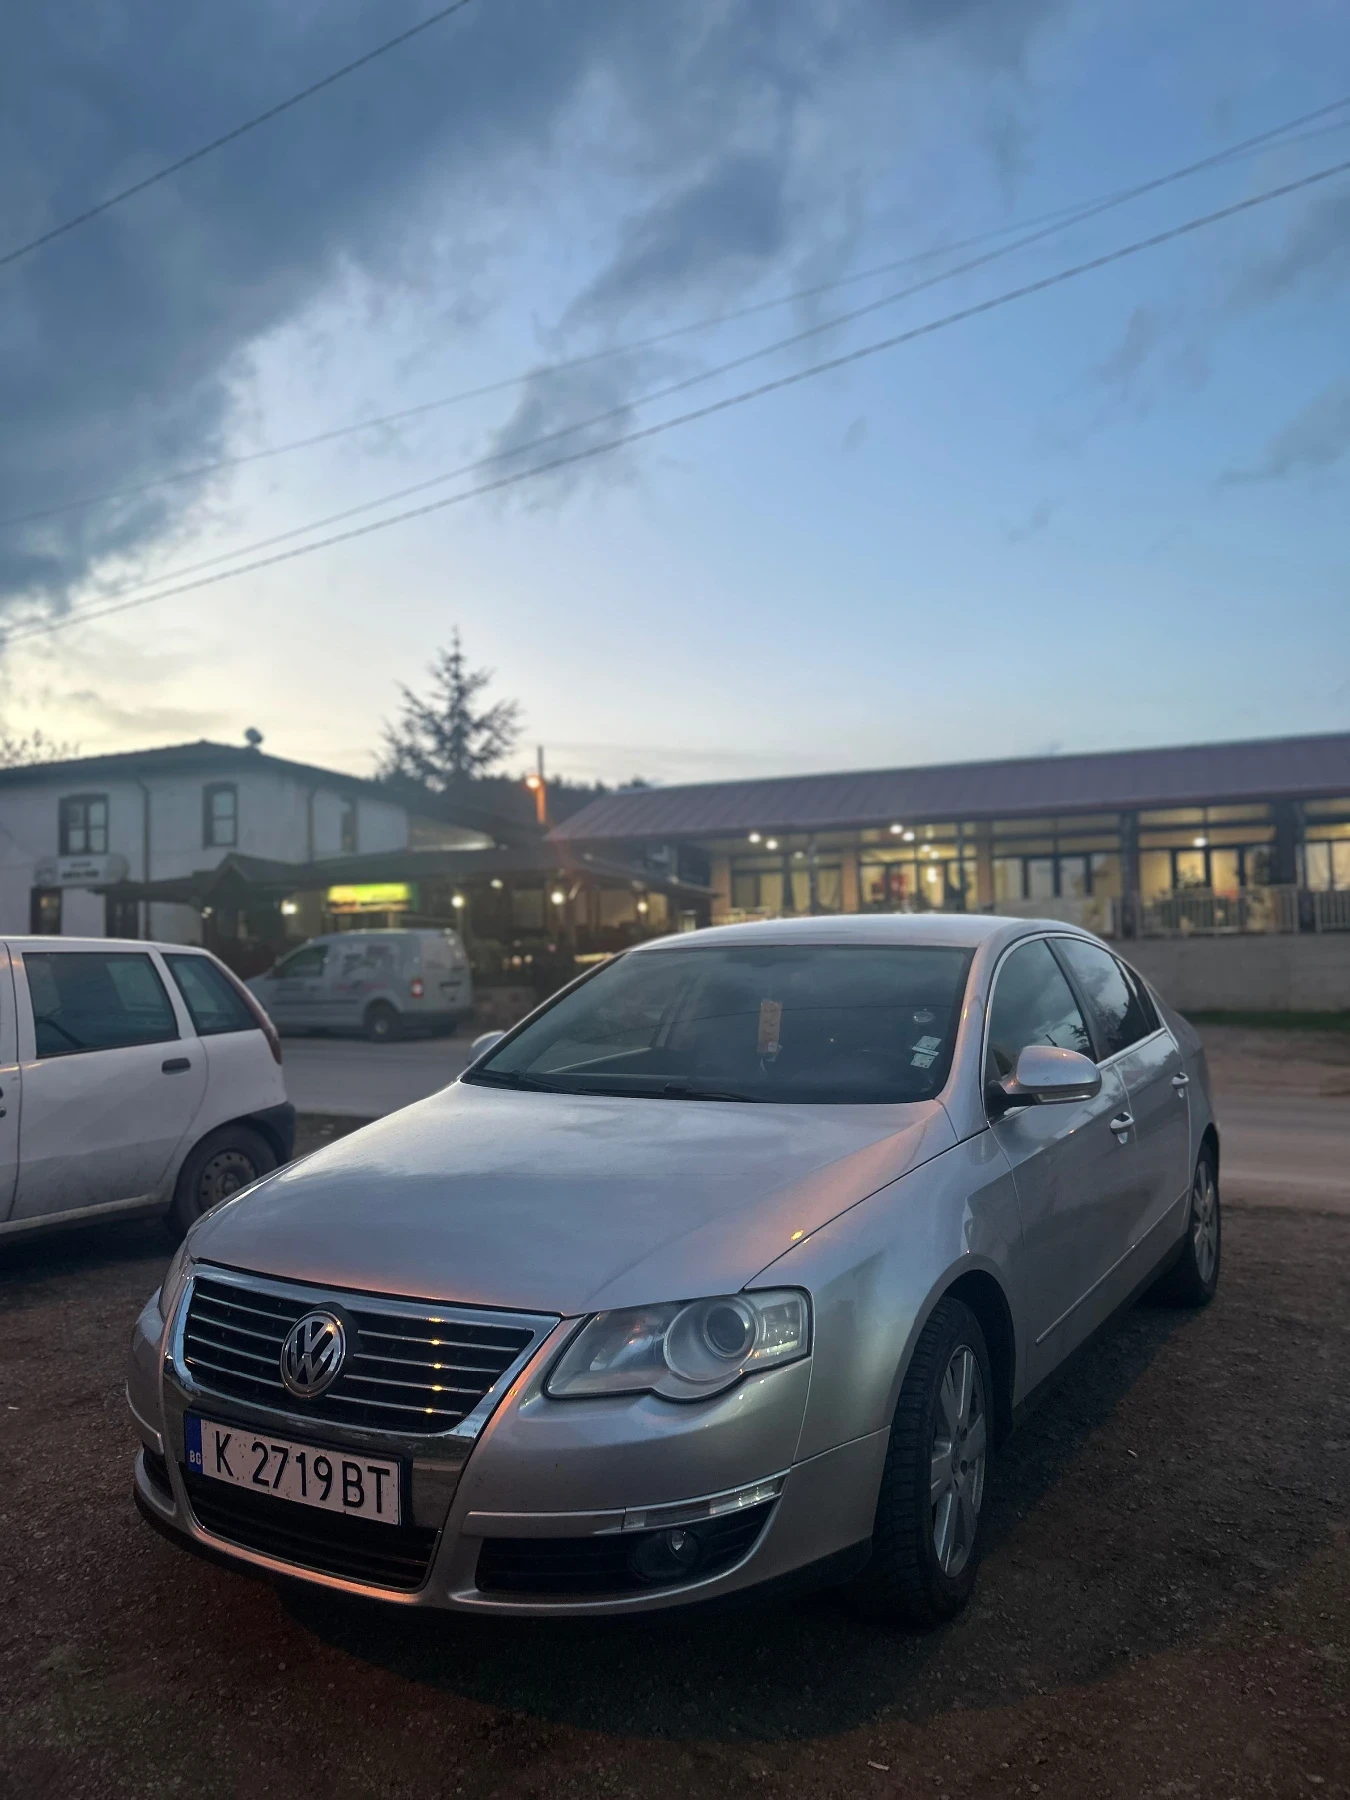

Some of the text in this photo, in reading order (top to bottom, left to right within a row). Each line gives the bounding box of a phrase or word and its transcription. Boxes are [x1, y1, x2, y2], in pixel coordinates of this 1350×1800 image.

[283, 1313, 343, 1391] VW
[189, 1450, 201, 1465] BG
[215, 1430, 234, 1477] K
